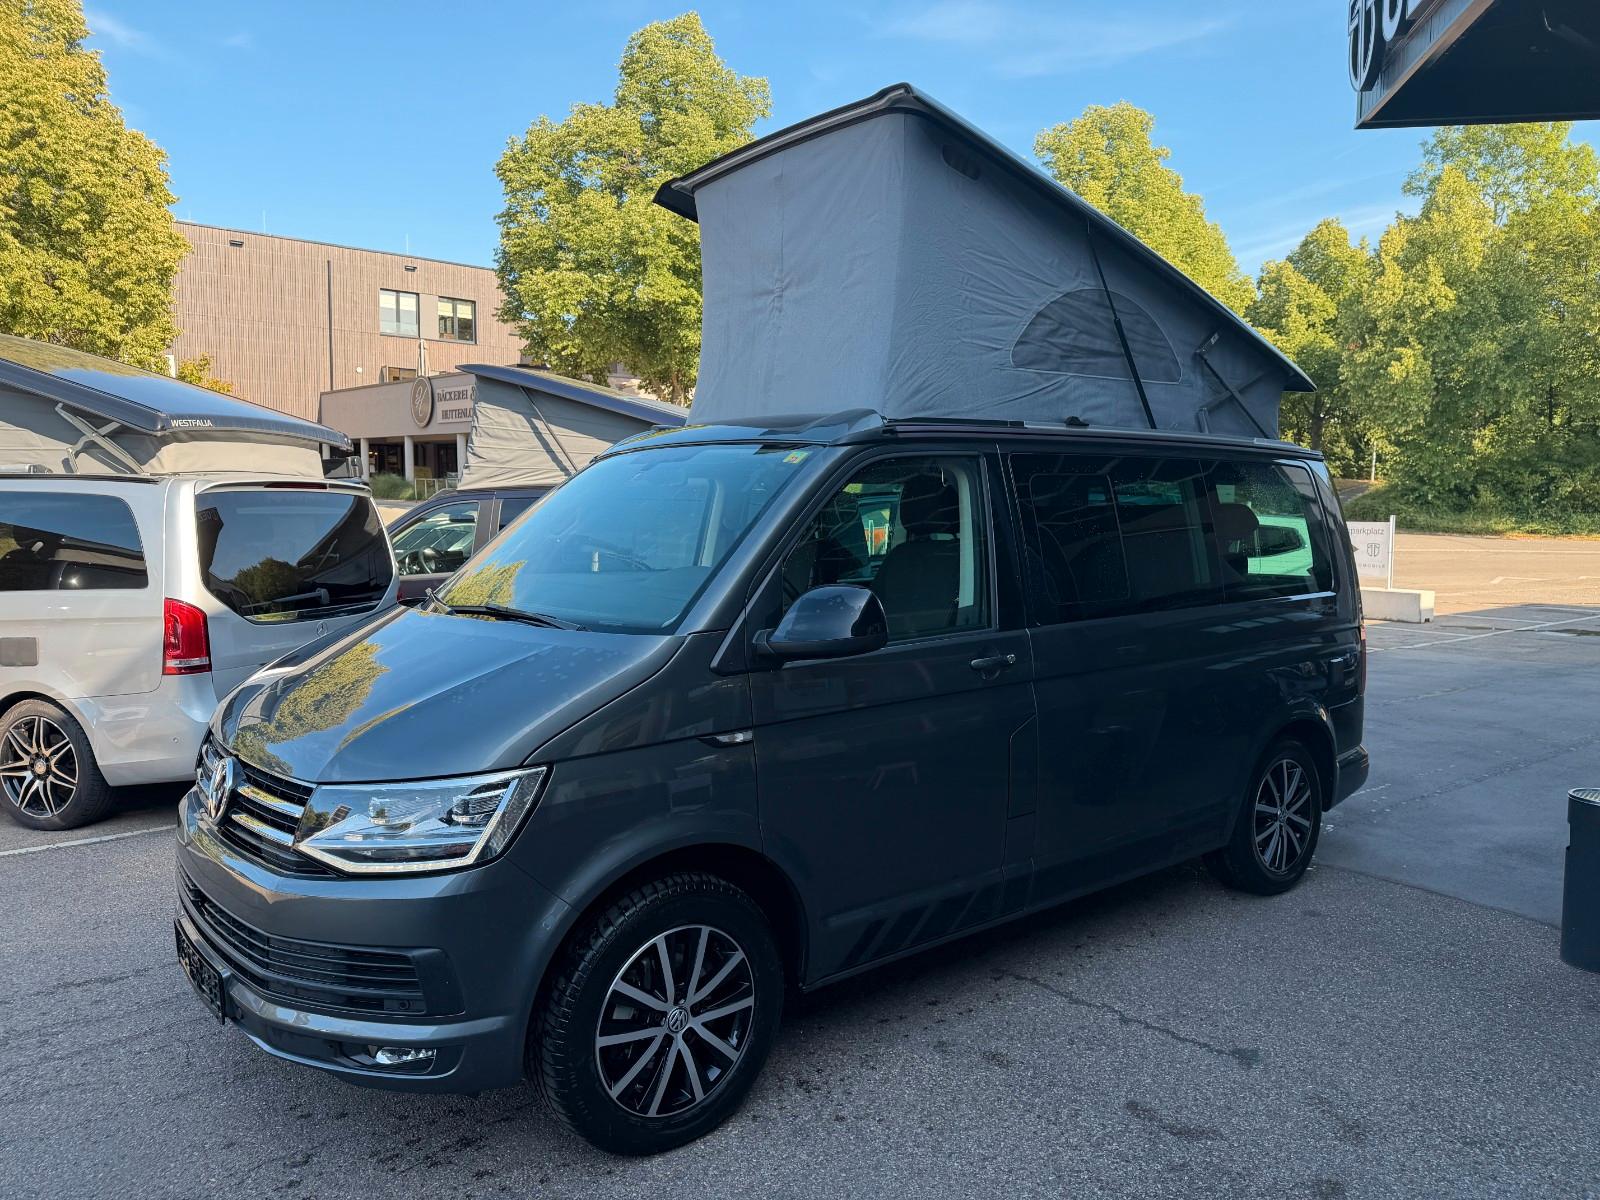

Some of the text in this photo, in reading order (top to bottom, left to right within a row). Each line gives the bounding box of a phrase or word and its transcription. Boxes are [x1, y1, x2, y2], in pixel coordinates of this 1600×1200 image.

[437, 389, 468, 403] BÄCKEREI
[170, 419, 213, 427] WESTFALIA
[1350, 527, 1385, 537] parkplatz
